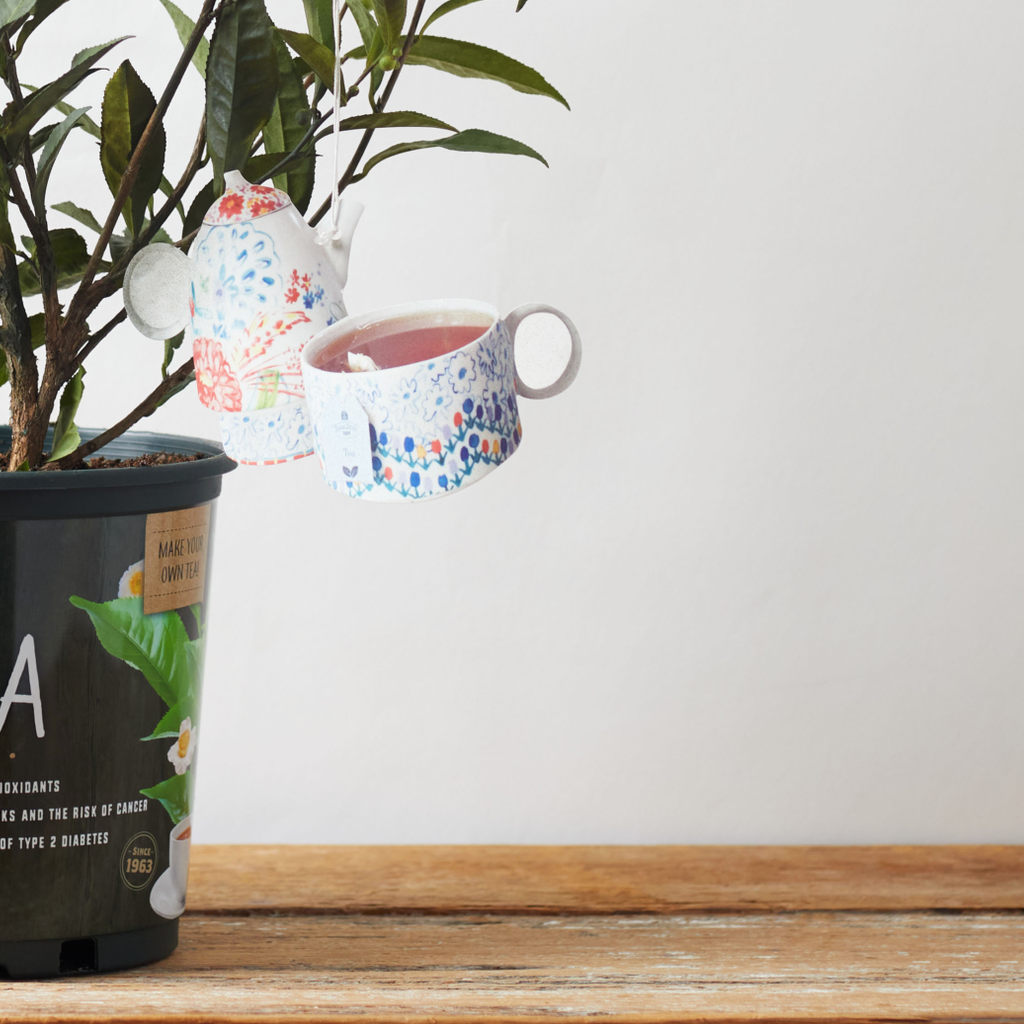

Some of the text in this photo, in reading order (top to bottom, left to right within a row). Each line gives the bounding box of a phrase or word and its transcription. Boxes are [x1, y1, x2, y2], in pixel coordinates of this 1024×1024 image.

[158, 534, 204, 559] MAKE YOUR
[161, 561, 200, 584] OWN TEA!
[21, 808, 44, 822] AND
[48, 807, 69, 820] THE
[72, 805, 98, 819] RISK
[101, 803, 113, 817] OF
[116, 798, 149, 815] CANCER
[0, 837, 13, 850] OF
[18, 836, 45, 849] TYPE
[50, 835, 57, 848] 2
[61, 831, 109, 848] DIABETES
[125, 857, 154, 874] 1963
